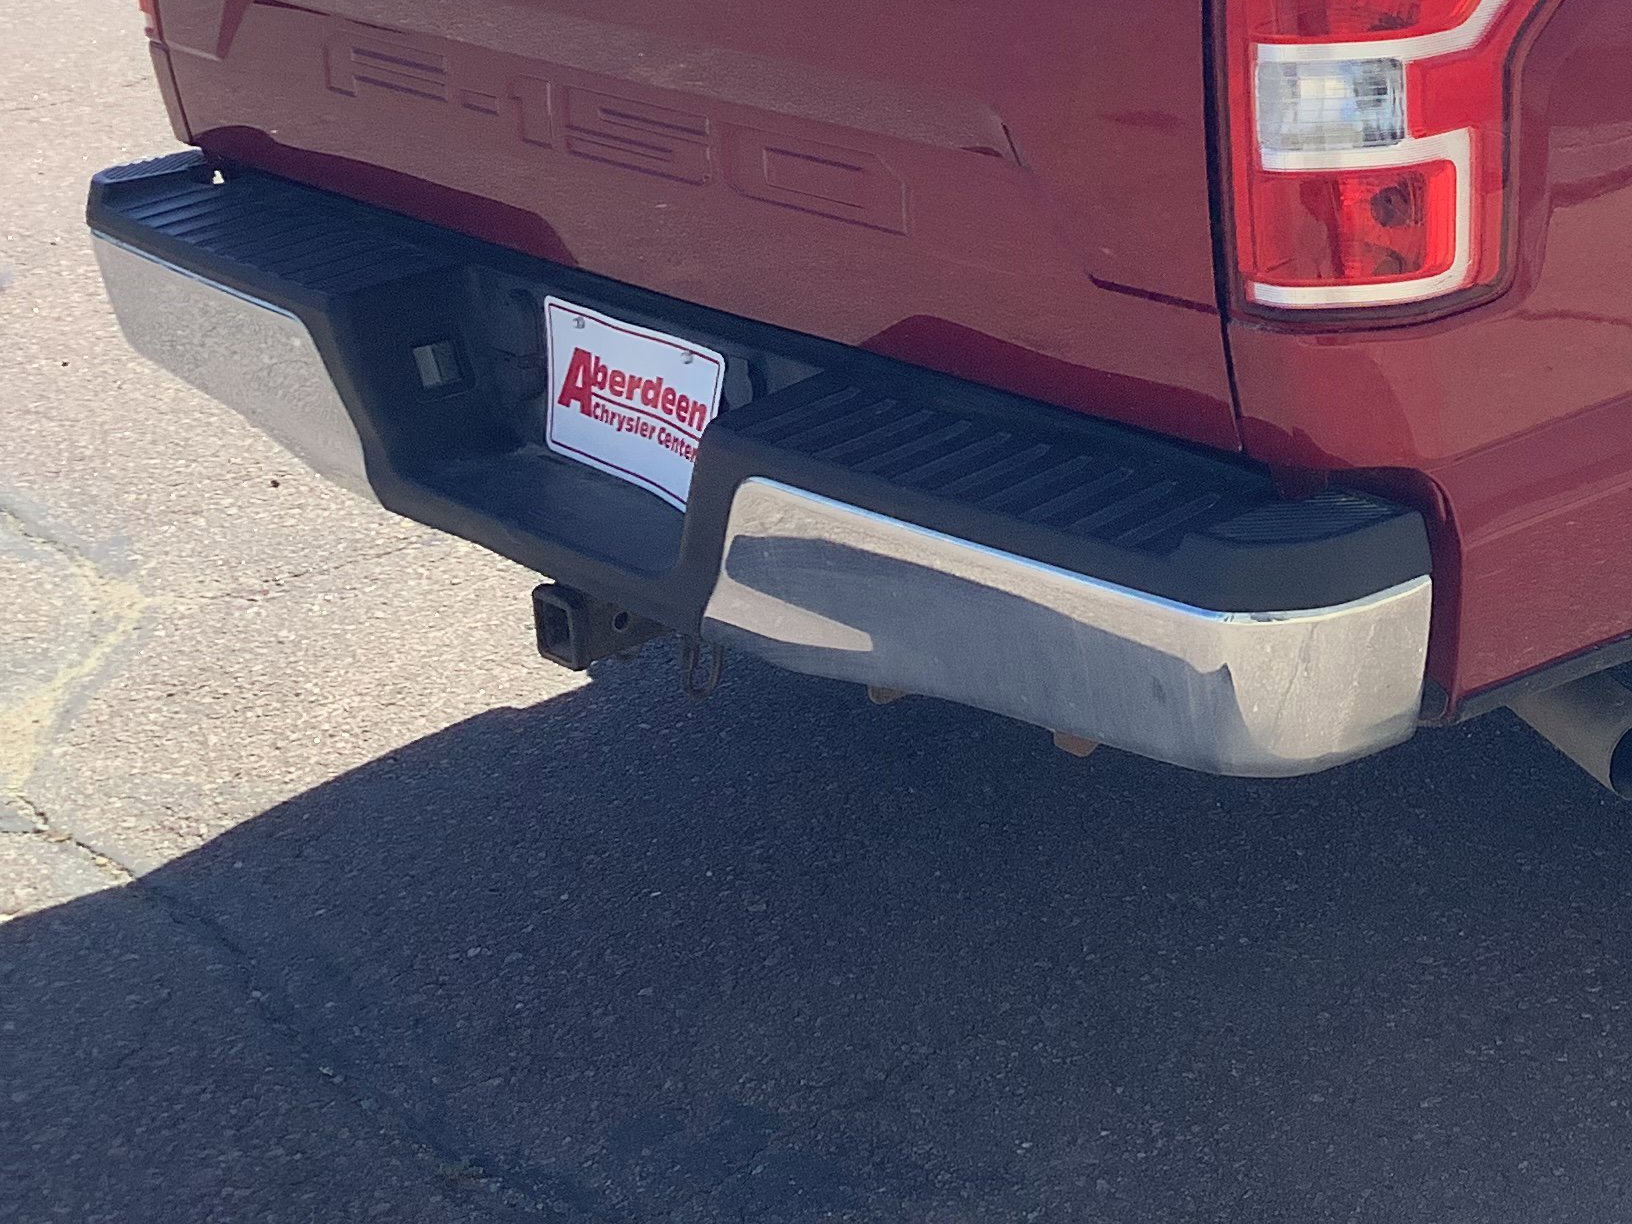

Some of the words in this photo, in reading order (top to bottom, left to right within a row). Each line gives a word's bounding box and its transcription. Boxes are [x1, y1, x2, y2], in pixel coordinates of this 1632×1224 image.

[322, 28, 912, 238] F-150
[557, 346, 708, 432] Aberdeen
[592, 400, 655, 440] Chrysler
